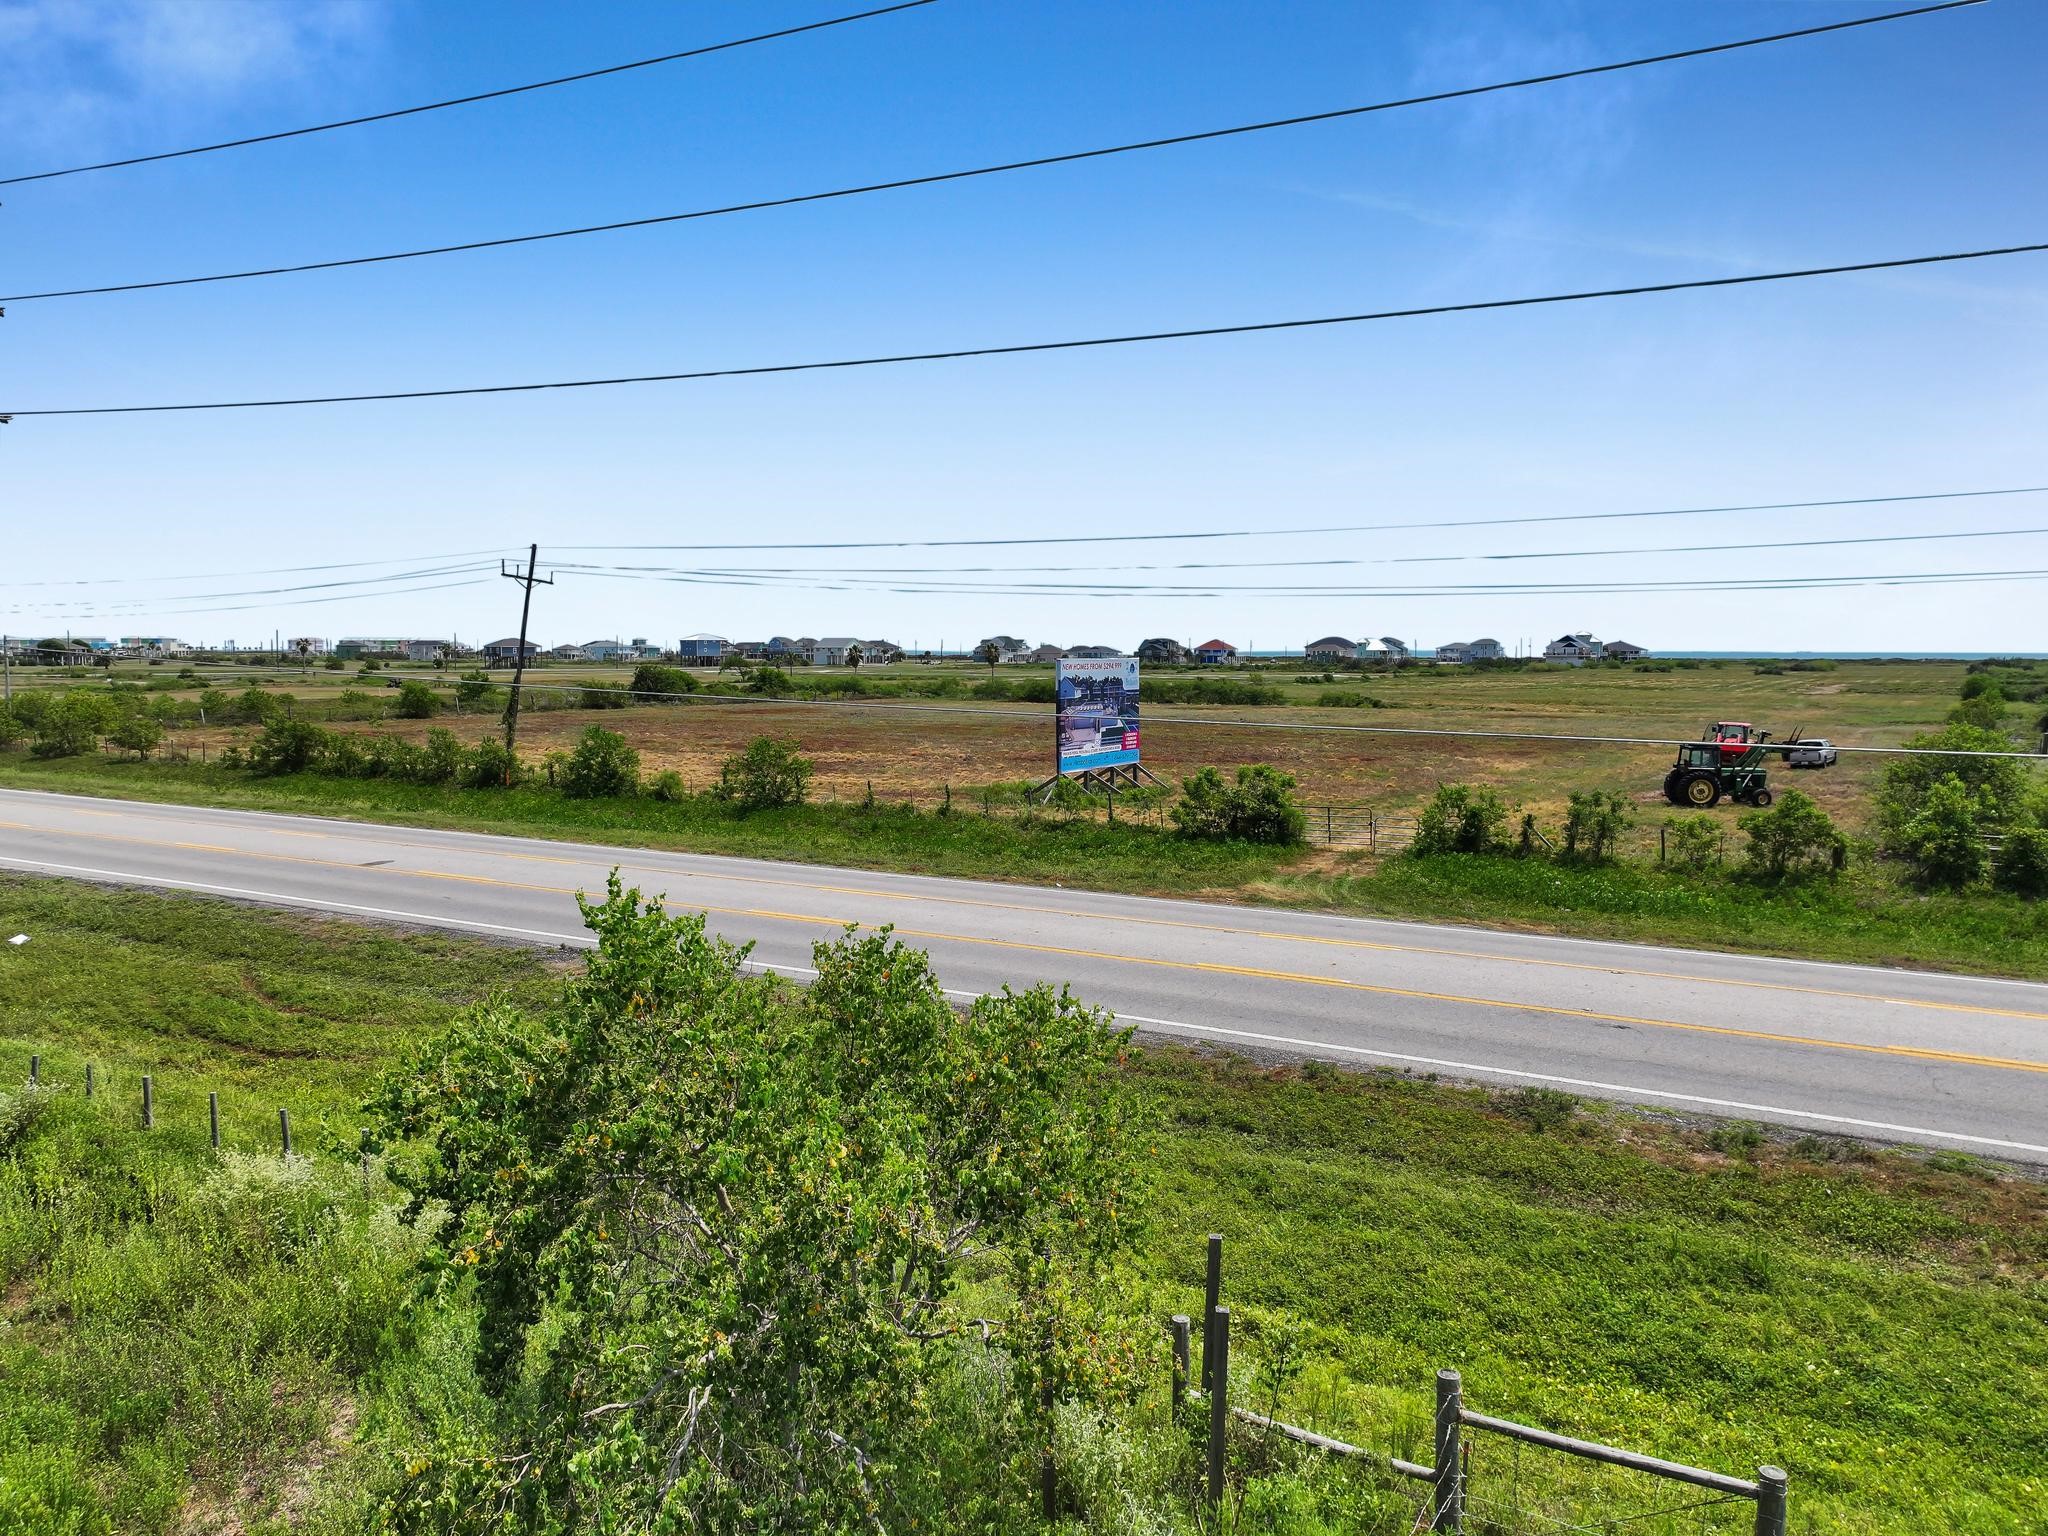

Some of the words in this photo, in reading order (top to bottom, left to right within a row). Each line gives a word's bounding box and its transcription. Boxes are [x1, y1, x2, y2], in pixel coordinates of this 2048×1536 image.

[1062, 663, 1073, 671] NEW
[1073, 663, 1089, 671] HOMES
[1090, 662, 1103, 670] FROM
